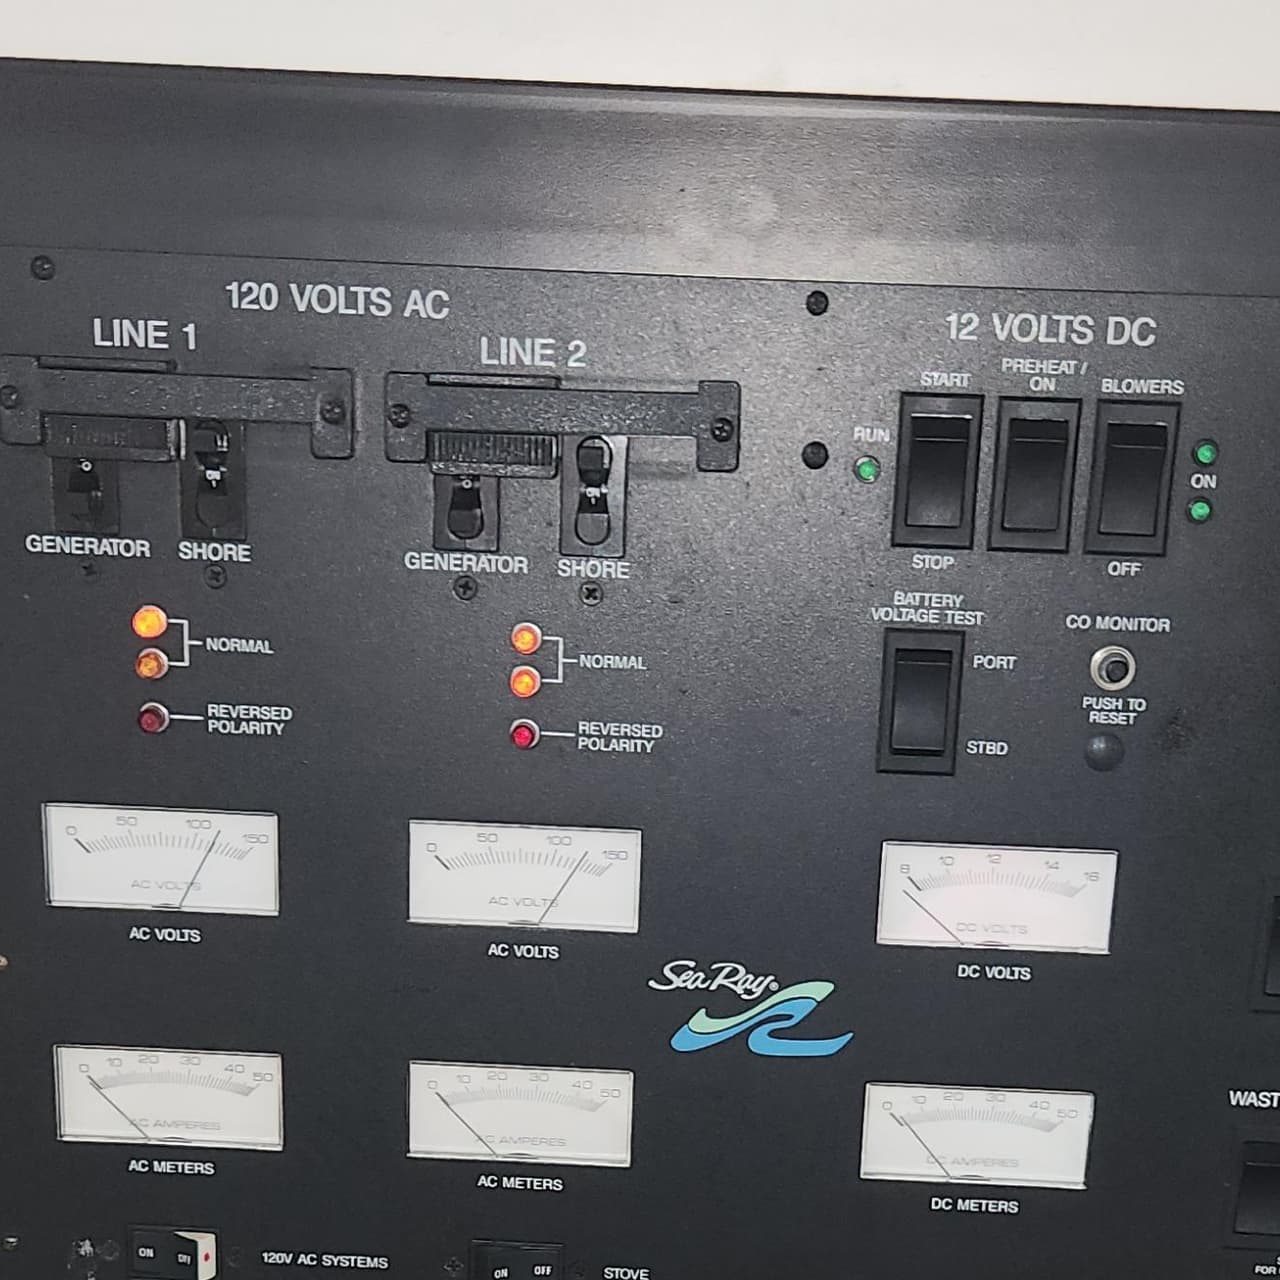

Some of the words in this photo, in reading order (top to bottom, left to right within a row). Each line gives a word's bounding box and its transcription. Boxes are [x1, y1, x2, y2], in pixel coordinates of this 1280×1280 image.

[225, 281, 279, 311] 120
[289, 283, 392, 317] VOLTS
[403, 289, 450, 320] AC
[93, 318, 169, 349] LINE
[182, 323, 196, 350] 1
[945, 310, 980, 341] 12
[991, 312, 1095, 345] VOLTS
[1106, 316, 1157, 347] DC
[480, 336, 557, 368] LINE
[567, 339, 587, 368] 2
[919, 368, 972, 388] START
[1029, 376, 1056, 392] ON
[1101, 378, 1185, 395] BLOWERS
[853, 425, 890, 443] RUN
[1190, 473, 1217, 489] ON
[25, 534, 151, 558] GENERATOR
[178, 541, 252, 562] SHORE
[404, 551, 529, 574] GENERATOR
[557, 557, 631, 579] SHORE
[911, 553, 955, 570] STOP
[1107, 561, 1142, 577] OFF
[893, 590, 964, 608] BATTERY
[870, 607, 941, 624] VOLTAGE
[943, 609, 985, 626] TEST
[1065, 614, 1092, 629] CO
[1095, 615, 1171, 633] MONITOR
[206, 637, 275, 654] NORMAL
[579, 654, 647, 670] NORMAL
[973, 655, 1018, 670] PORT
[1082, 696, 1123, 710] PUSH
[1127, 698, 1147, 712] TO
[207, 703, 293, 723] REVERSED
[1089, 710, 1138, 725] RESET
[207, 719, 285, 735] POLARITY
[578, 721, 664, 738] REVERSED
[577, 734, 657, 753] POLARITY
[966, 740, 1009, 755] STBD
[129, 926, 151, 941] AC
[154, 928, 201, 943] VOLTS
[487, 943, 509, 957] AC
[513, 944, 560, 960] VOLTS
[648, 960, 712, 991] Sea
[957, 964, 981, 978] DC
[985, 965, 1032, 981] VOLTS
[128, 1159, 149, 1172] AC
[152, 1160, 215, 1175] METERS
[477, 1175, 498, 1188] AC
[502, 1176, 563, 1191] METERS
[931, 1197, 953, 1211] DC
[956, 1198, 1019, 1214] METERS
[262, 1252, 294, 1264] 120V
[296, 1253, 317, 1265] AC
[321, 1254, 389, 1269] SYSTEMS
[603, 1267, 650, 1280] STOVE
[1254, 1265, 1277, 1275] FOR
